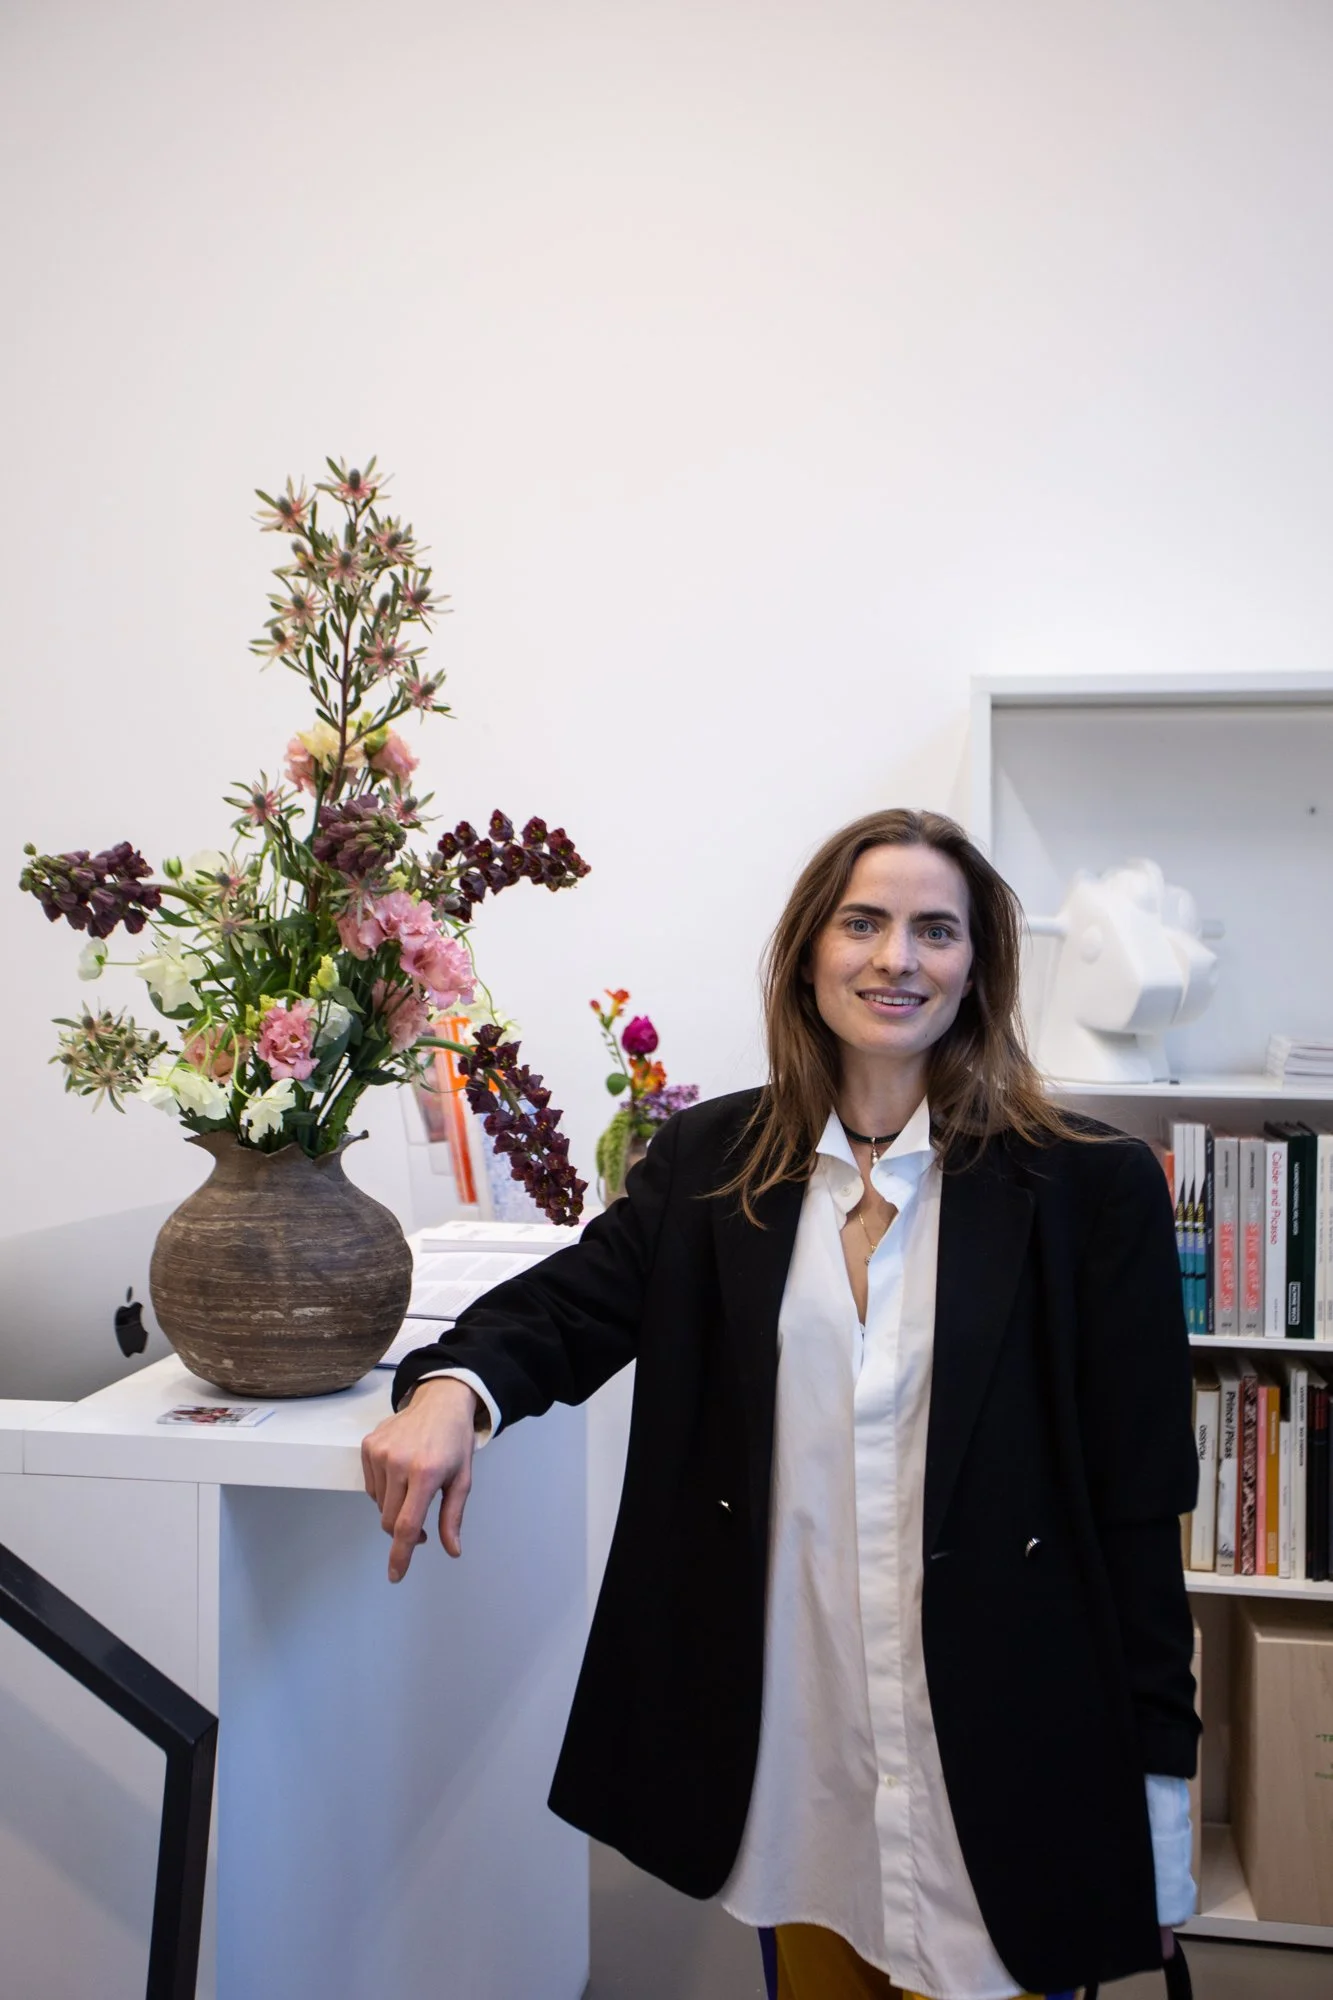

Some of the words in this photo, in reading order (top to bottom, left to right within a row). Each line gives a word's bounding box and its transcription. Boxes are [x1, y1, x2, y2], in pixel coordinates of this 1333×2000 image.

[1271, 1151, 1282, 1185] Calder
[1271, 1188, 1281, 1207] and
[1270, 1209, 1281, 1245] Picasso
[1225, 1391, 1236, 1423] Prince
